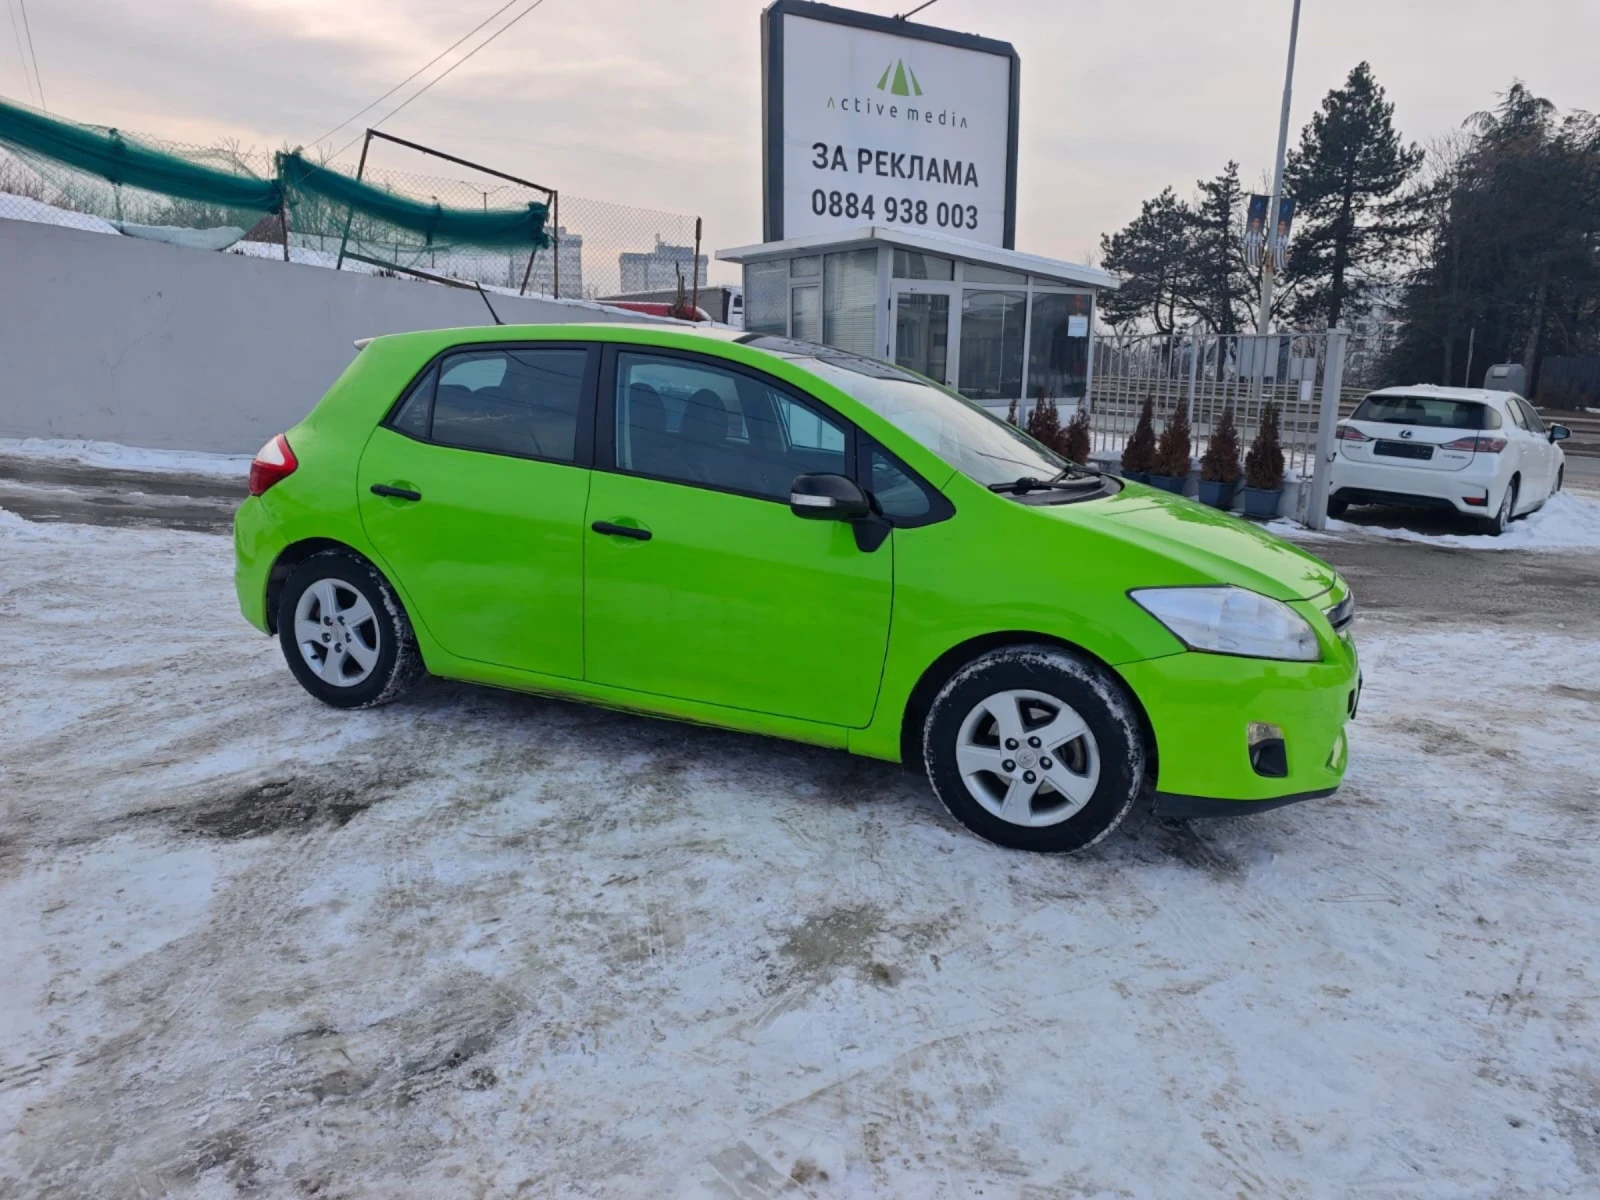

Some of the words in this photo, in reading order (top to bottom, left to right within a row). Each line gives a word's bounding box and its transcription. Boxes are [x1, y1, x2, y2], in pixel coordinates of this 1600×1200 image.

[811, 142, 849, 173] ЗА
[857, 147, 980, 188] РЕКЛАМА
[811, 188, 876, 221] 0884
[884, 196, 928, 226] 938
[936, 202, 979, 230] 003
